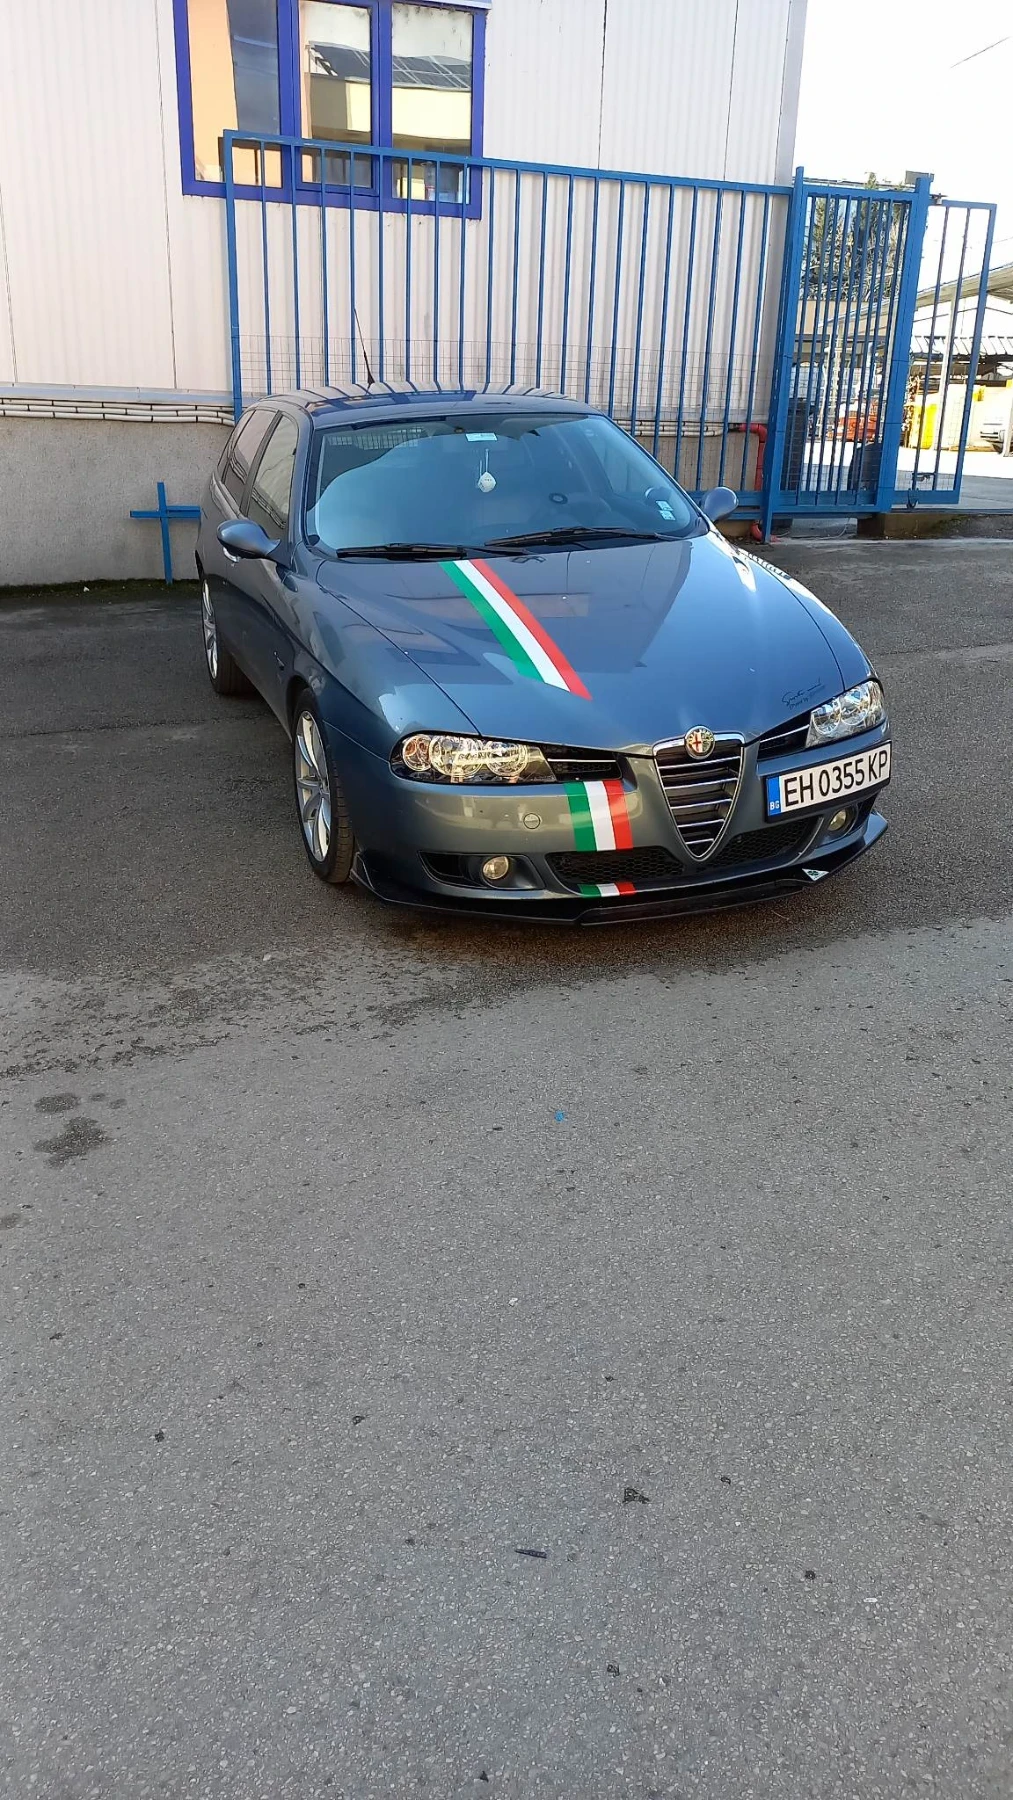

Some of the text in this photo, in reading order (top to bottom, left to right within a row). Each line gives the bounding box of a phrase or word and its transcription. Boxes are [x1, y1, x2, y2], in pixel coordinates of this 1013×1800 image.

[784, 749, 888, 807] EH 0355 KP
[769, 800, 780, 810] BG
